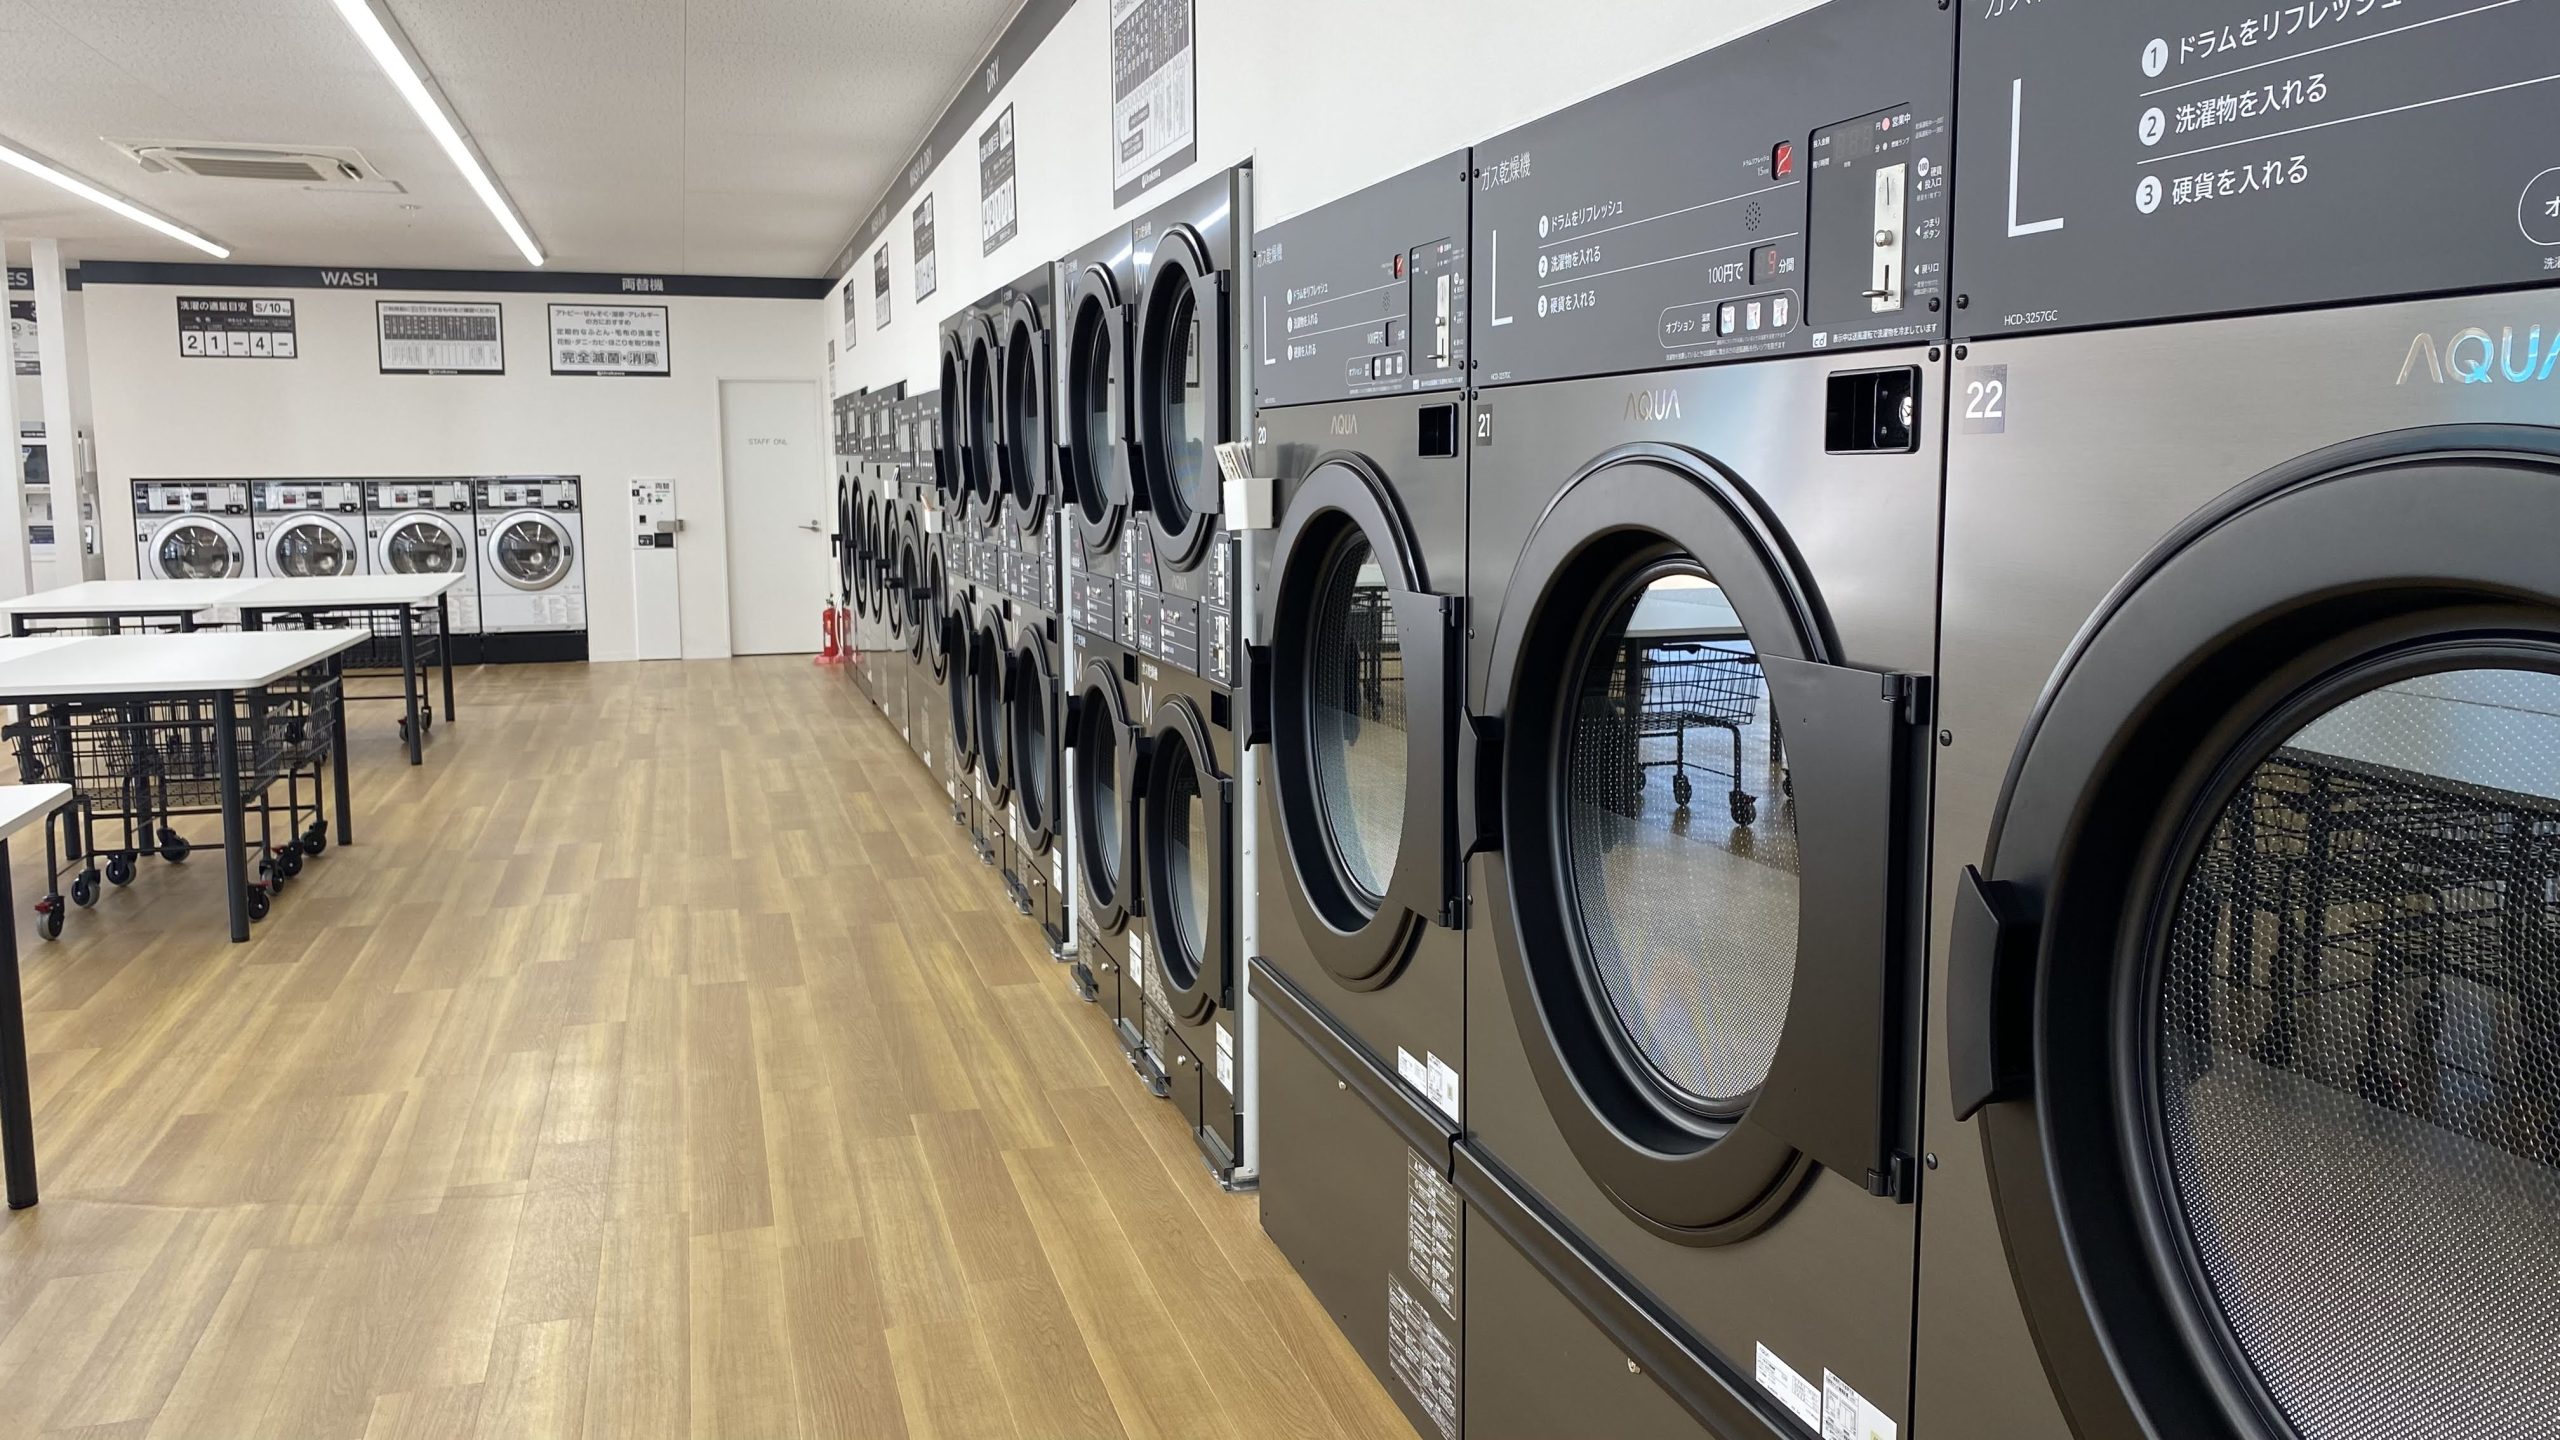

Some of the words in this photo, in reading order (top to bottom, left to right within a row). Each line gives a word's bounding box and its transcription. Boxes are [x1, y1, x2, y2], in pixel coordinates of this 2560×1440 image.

[987, 56, 999, 94] DRY
[2175, 73, 2327, 134] 洗濯物を入れる
[2008, 78, 2064, 237] L
[1481, 151, 1531, 191] ガス乾燥機
[2172, 155, 2308, 205] 硬貨を入れる
[1551, 201, 1624, 232] ドラムをリフレッシュ
[1923, 217, 1940, 228] つまり
[1922, 228, 1940, 240] ボタン
[1550, 246, 1601, 272] 洗濯物を入れる
[1778, 257, 1795, 274] 分間
[321, 271, 378, 287] WASH
[622, 277, 664, 292] 両替機
[1492, 230, 1513, 326] L
[1708, 262, 1744, 284] 100円で
[1550, 290, 1596, 314] 硬貨を入れる
[1665, 320, 1695, 334] オプション
[2004, 310, 2058, 325] HCD-3257GC
[1263, 296, 1276, 365] L
[187, 335, 198, 350] 2
[211, 335, 218, 350] 1
[255, 336, 265, 351] 4
[1624, 389, 1681, 421] AQUA
[1965, 380, 2003, 419] 22
[1258, 426, 1267, 445] 20
[1330, 413, 1358, 435] AQUA
[1477, 413, 1491, 438] 21
[748, 437, 769, 446] STAFF
[1141, 681, 1153, 726] M
